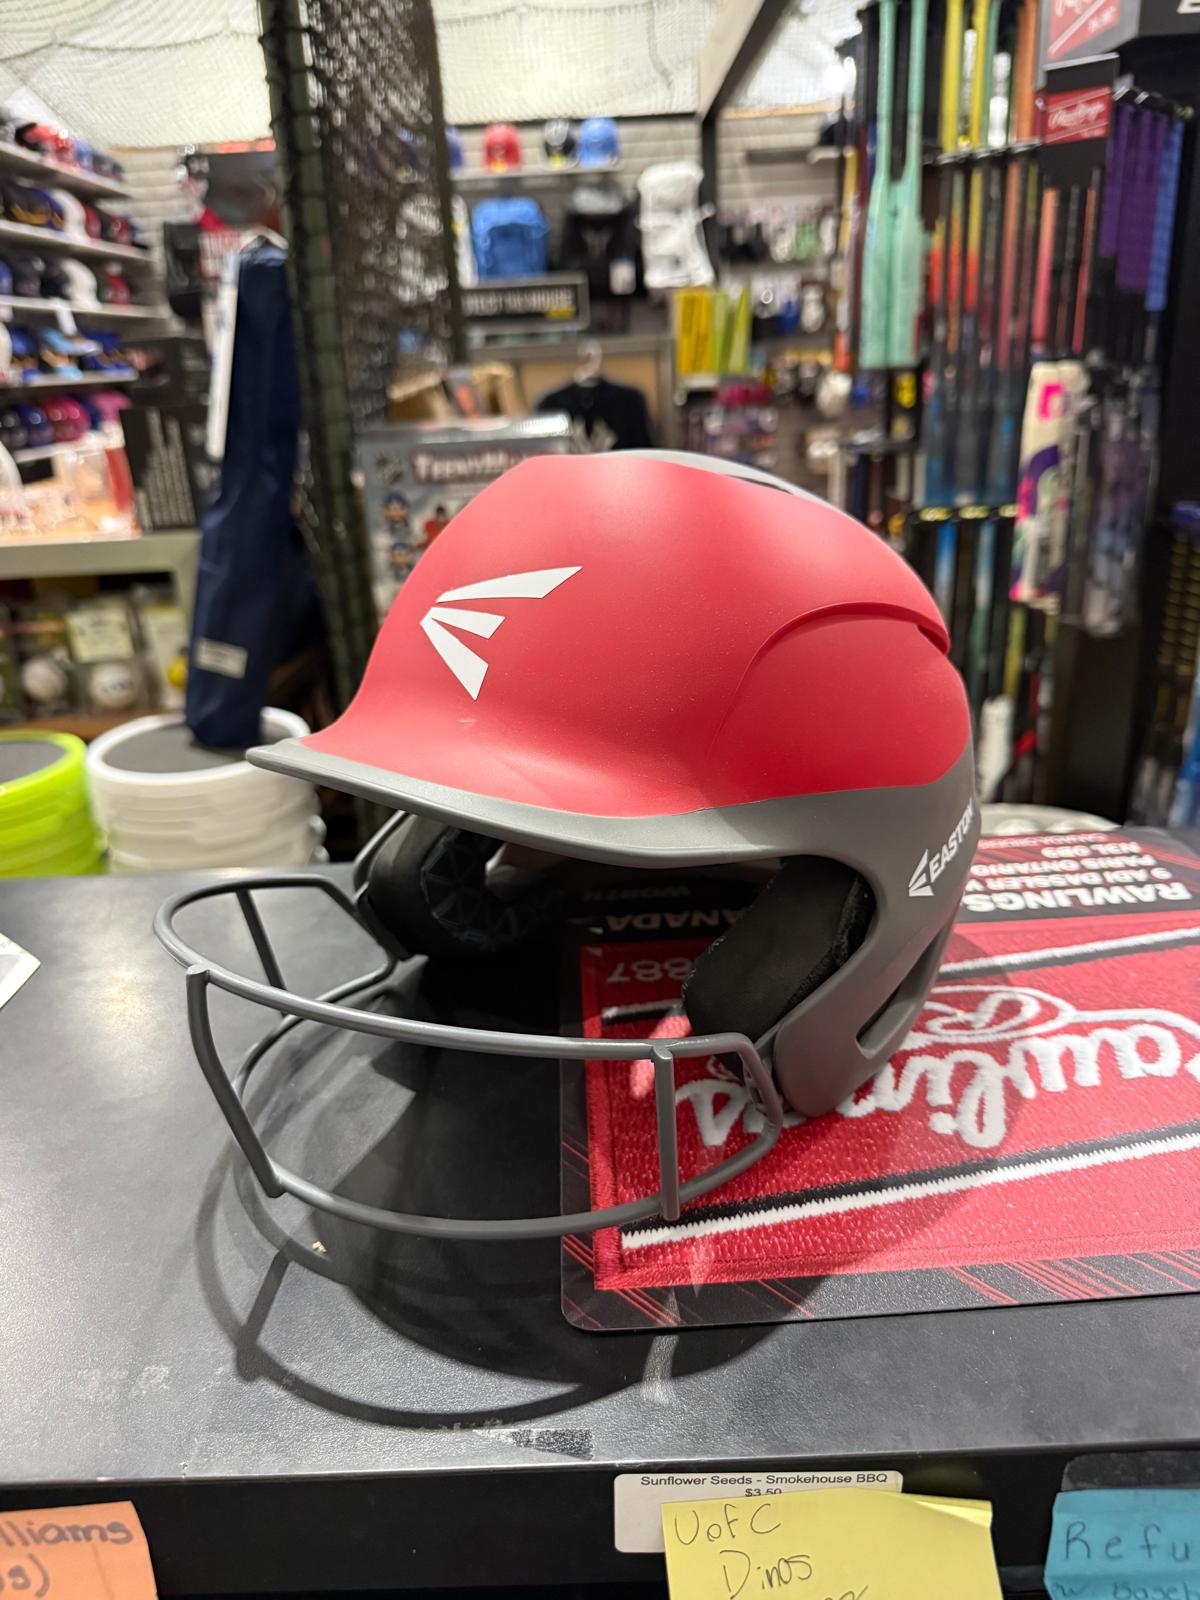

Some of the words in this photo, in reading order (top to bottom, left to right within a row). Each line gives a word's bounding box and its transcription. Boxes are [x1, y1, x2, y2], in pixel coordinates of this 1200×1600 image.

[1149, 867, 1173, 880] 9
[961, 881, 1193, 912] RAWLINGS
[605, 909, 737, 931] ANADA
[606, 957, 694, 983] 887
[640, 1475, 706, 1487] Sunflower
[710, 1475, 753, 1486] Seeds
[765, 1473, 853, 1485] Smokehouse
[856, 1472, 888, 1484] BBQ
